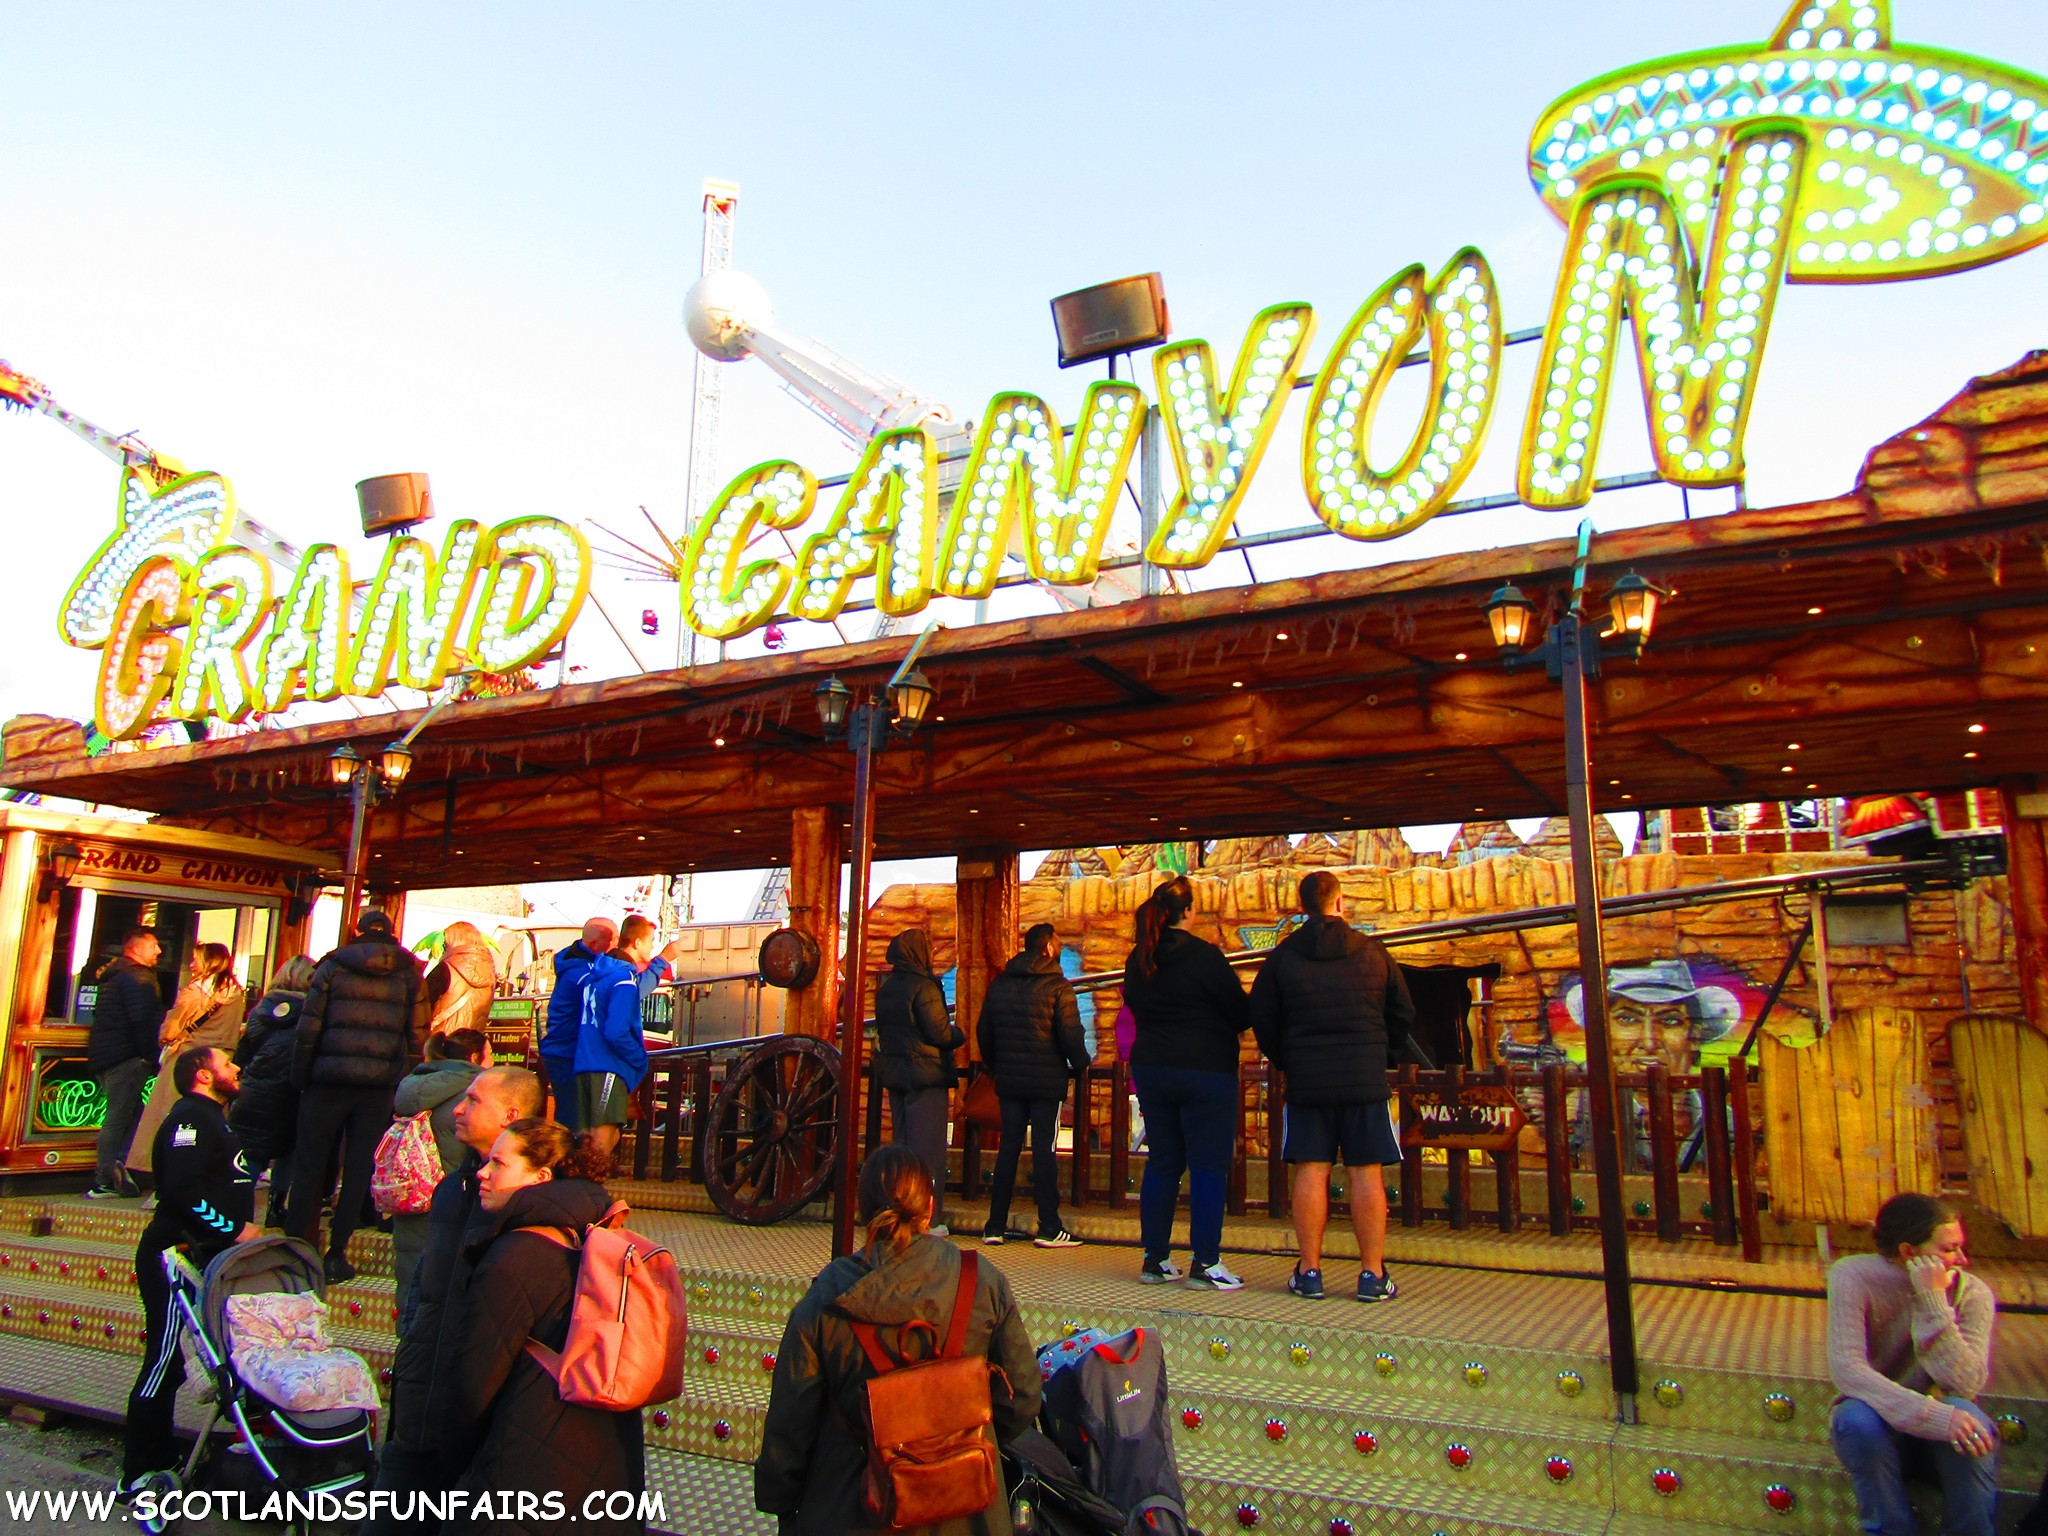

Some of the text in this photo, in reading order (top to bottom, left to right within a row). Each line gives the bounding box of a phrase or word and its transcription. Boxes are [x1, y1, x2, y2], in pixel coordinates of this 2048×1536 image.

[95, 116, 1811, 741] GRAND CANYON
[181, 860, 280, 888] CANYON
[1420, 1104, 1463, 1122] WA
[1116, 1388, 1141, 1402] LittleLife
